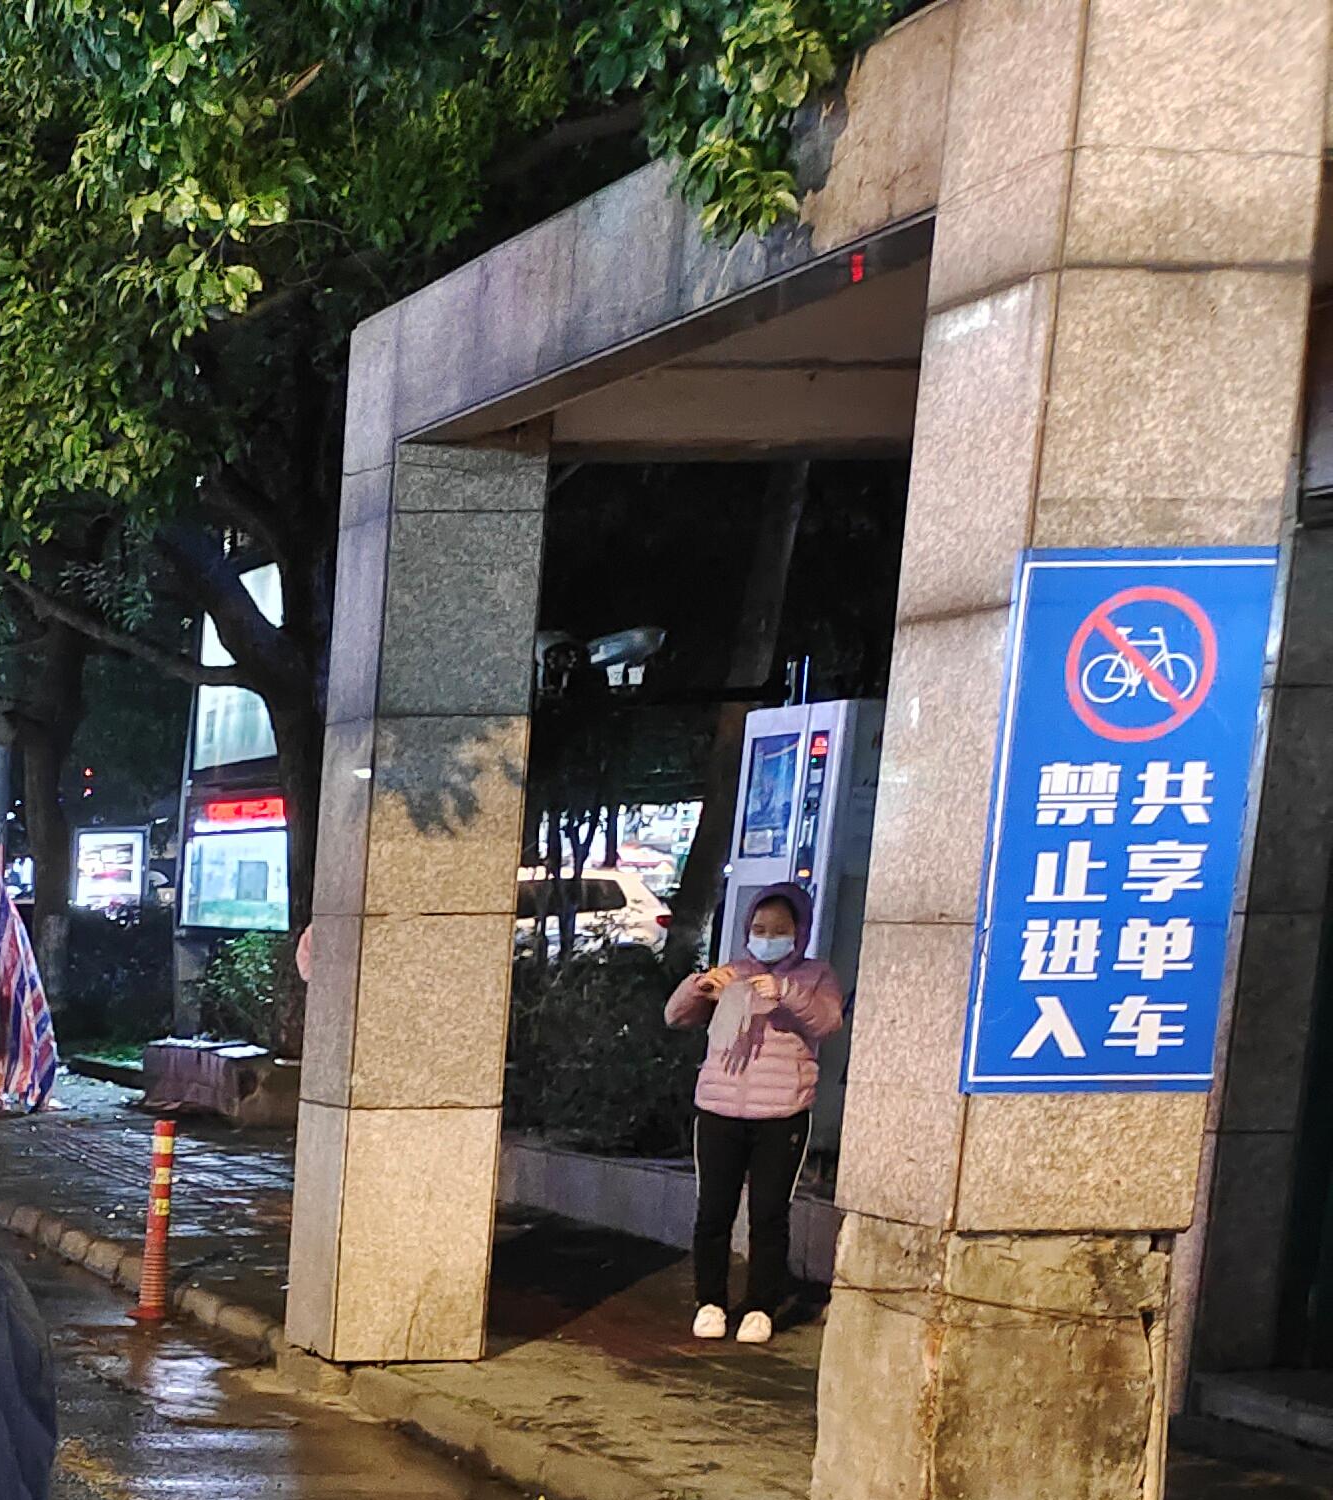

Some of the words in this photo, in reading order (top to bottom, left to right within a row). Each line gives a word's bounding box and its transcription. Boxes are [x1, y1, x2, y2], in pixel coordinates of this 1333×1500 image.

[1010, 761, 1121, 1058] 禁止进入
[1103, 761, 1214, 1057] 共享单车
